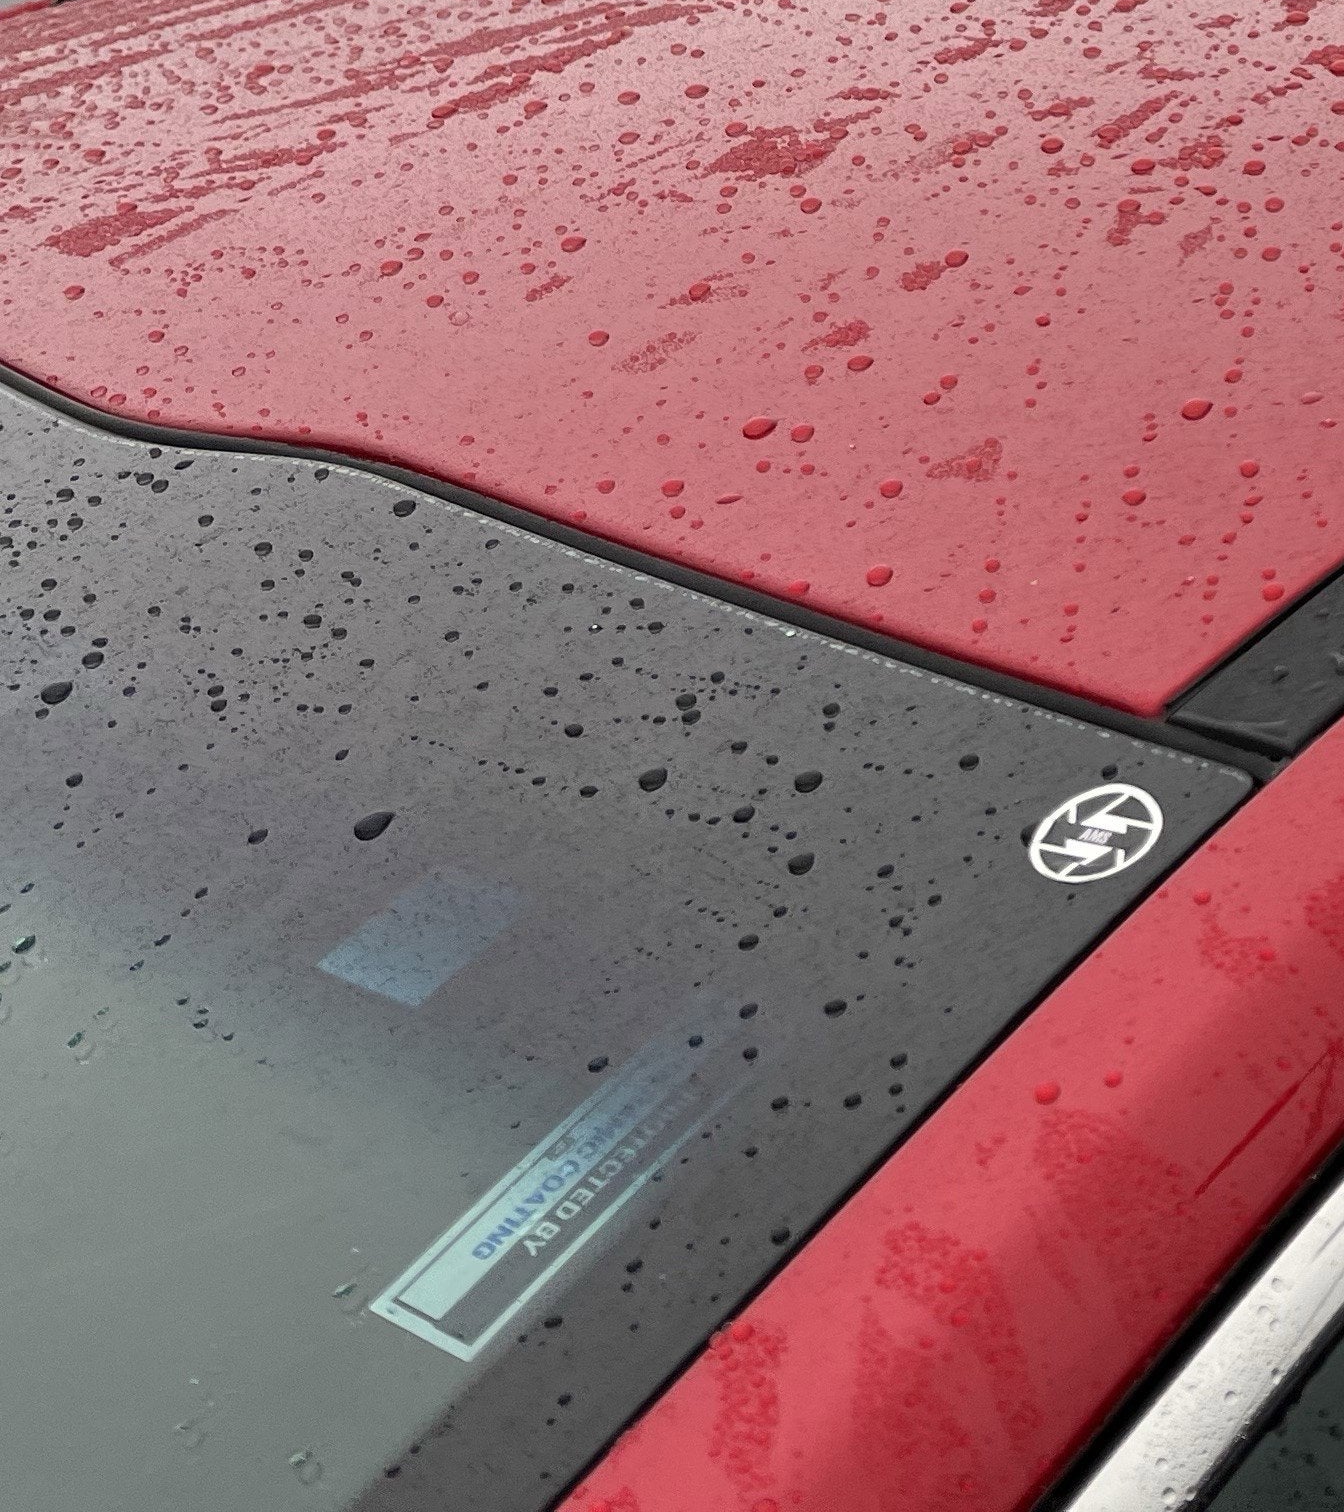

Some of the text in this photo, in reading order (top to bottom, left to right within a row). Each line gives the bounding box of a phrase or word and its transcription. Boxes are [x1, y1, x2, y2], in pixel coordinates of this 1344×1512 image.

[472, 1158, 580, 1260] COATING
[522, 1090, 698, 1257] TECTED BY
